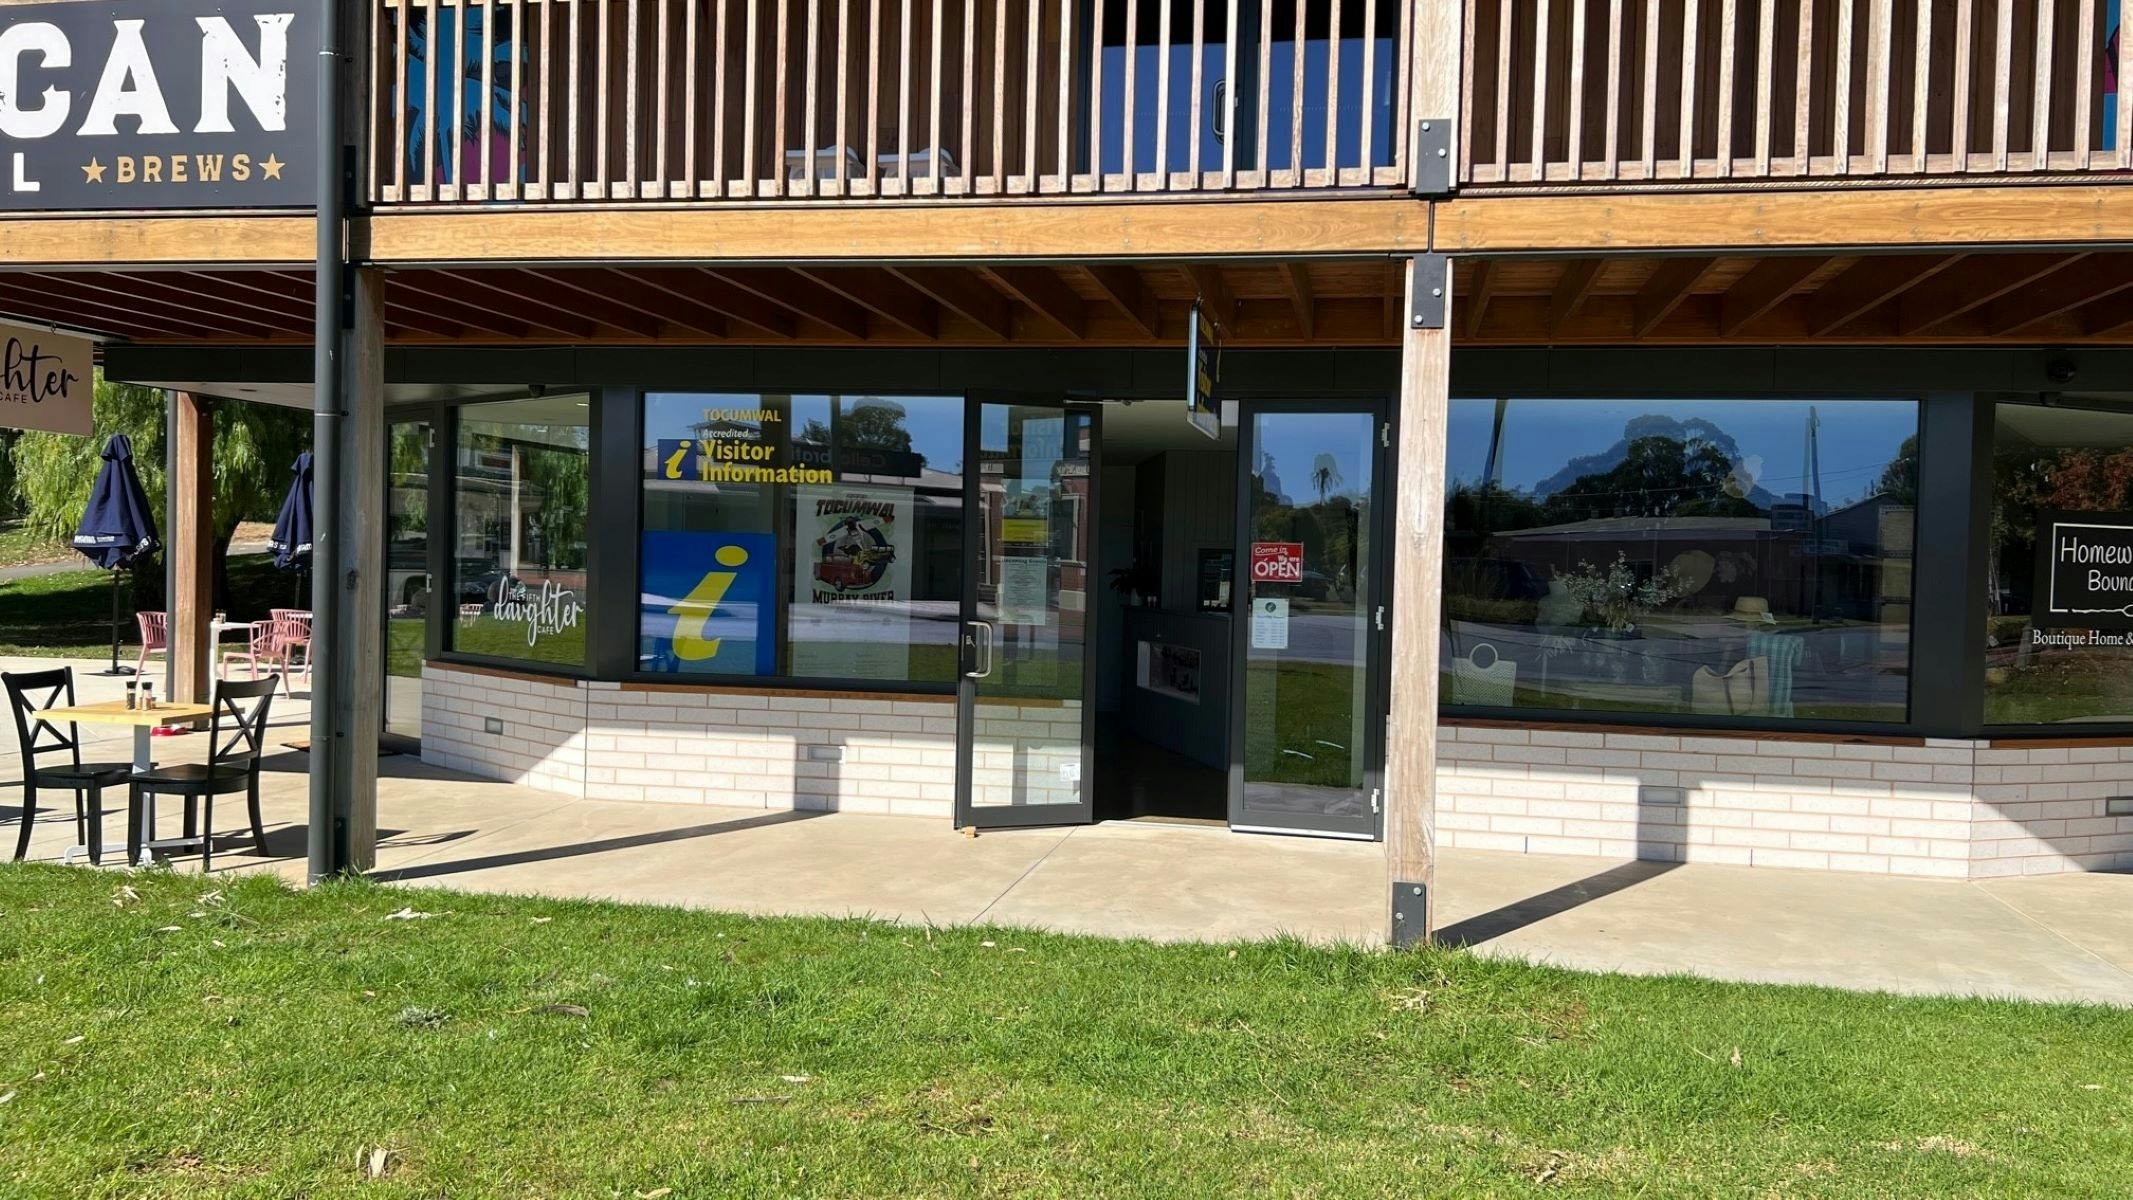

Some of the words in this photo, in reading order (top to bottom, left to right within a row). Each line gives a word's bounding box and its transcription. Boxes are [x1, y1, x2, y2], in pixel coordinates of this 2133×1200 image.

[0, 13, 295, 139] CAN
[13, 152, 41, 192] L
[116, 153, 251, 184] BREWS
[0, 337, 79, 403] hter
[703, 408, 782, 422] TOCUMWAL
[702, 428, 750, 439] Accredited
[702, 439, 775, 461] Visitor
[702, 461, 833, 484] Information
[815, 499, 896, 517] TOCUMWAL
[1255, 545, 1278, 554] Come
[1254, 561, 1300, 577] OPEN
[494, 576, 584, 647] daughter
[537, 625, 554, 635] CAFE
[2033, 629, 2086, 651] Boutique
[2088, 629, 2124, 645] Home
